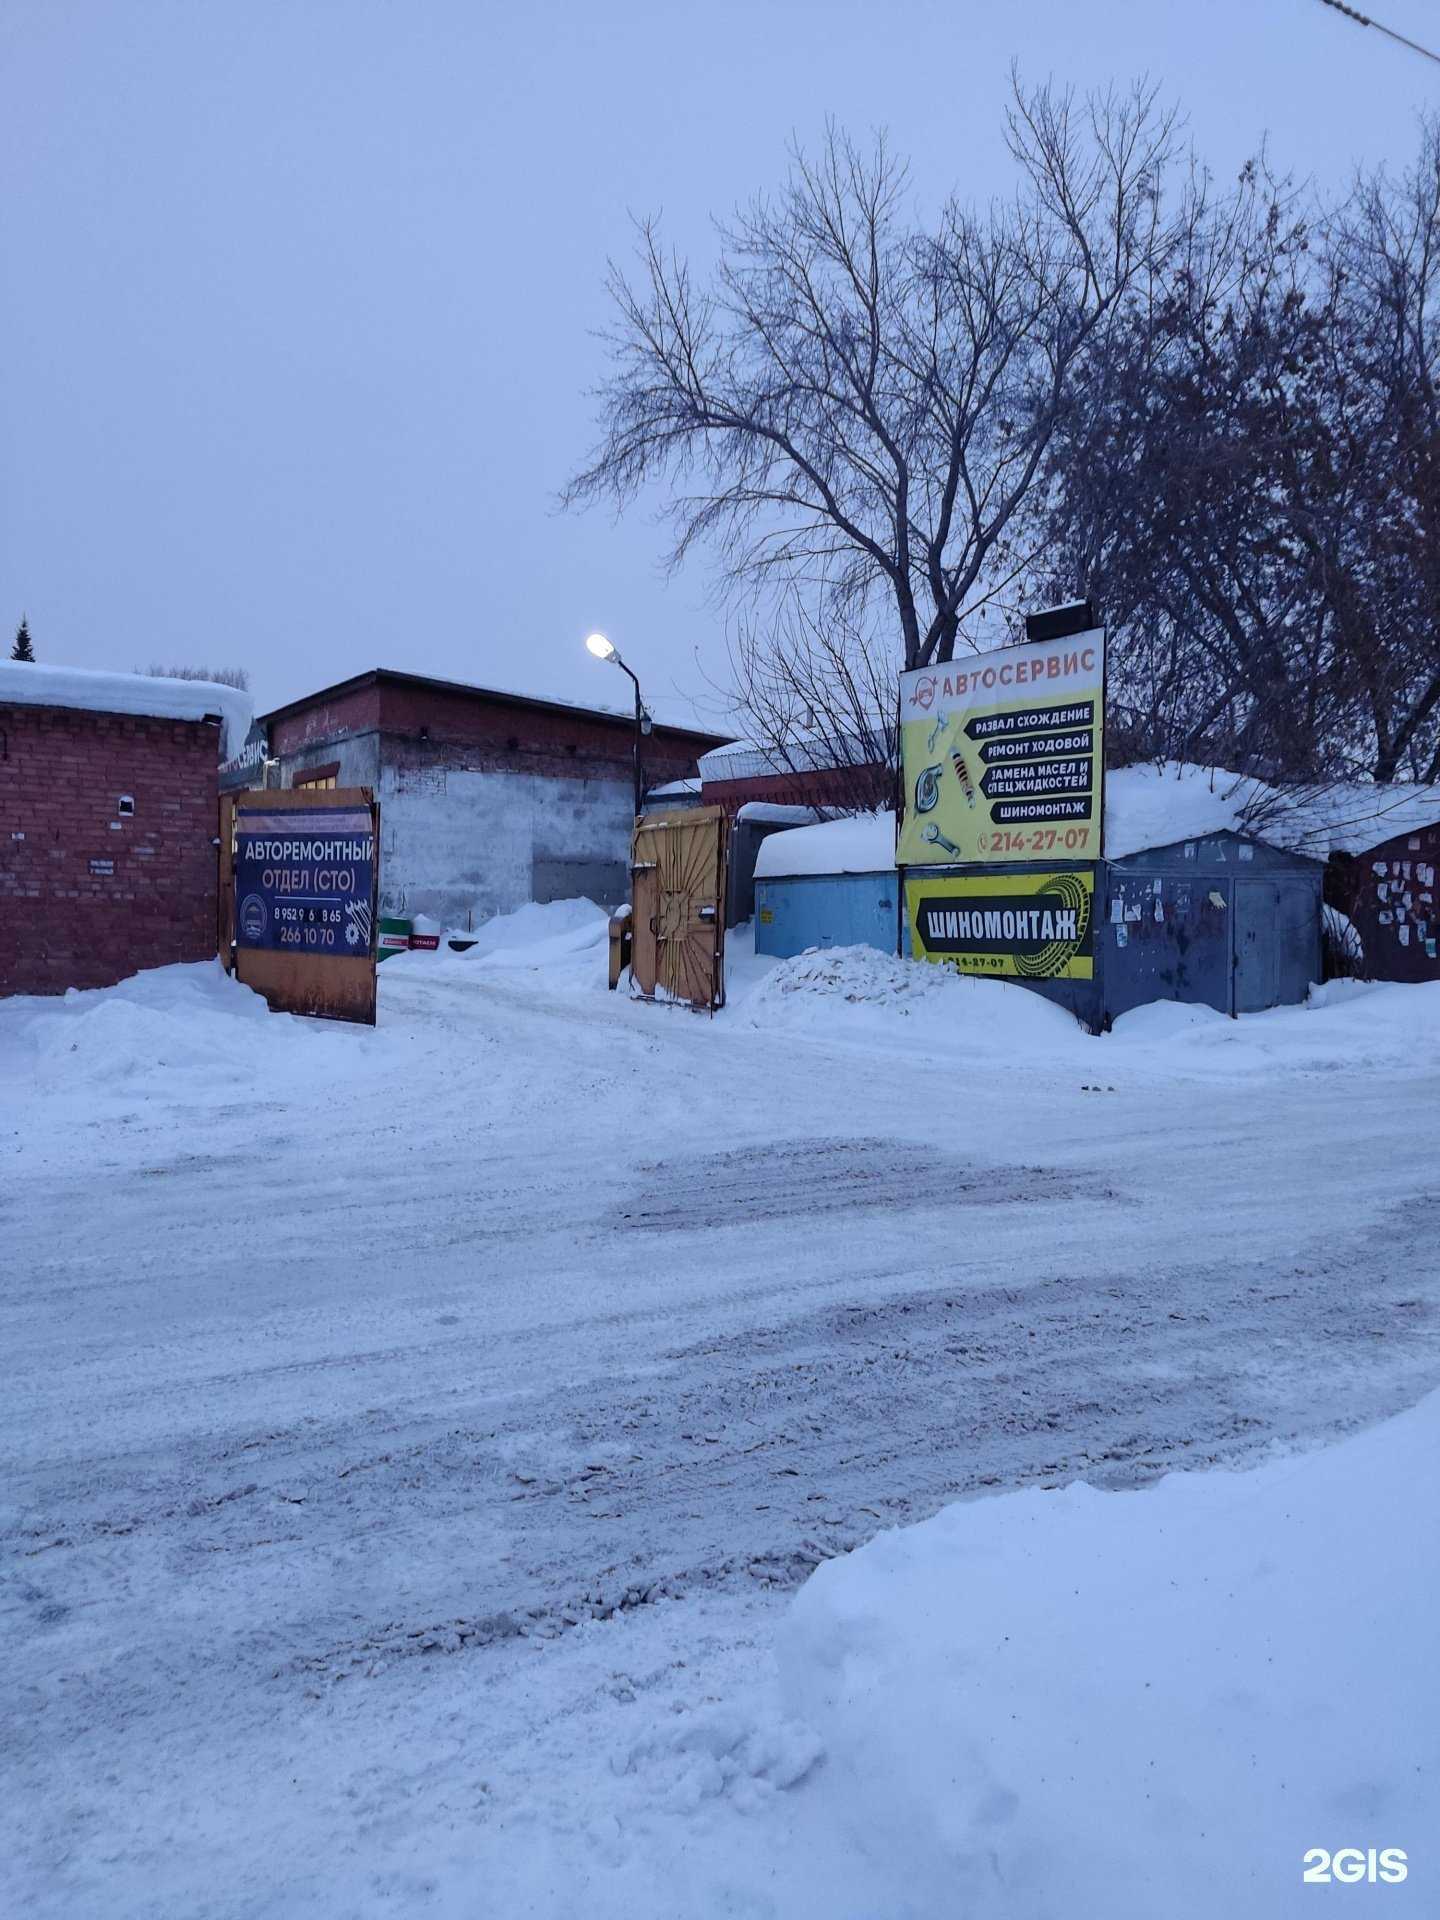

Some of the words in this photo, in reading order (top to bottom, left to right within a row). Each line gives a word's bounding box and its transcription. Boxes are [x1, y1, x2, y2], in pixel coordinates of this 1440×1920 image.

[942, 648, 1096, 699] АВТОСЕРВИС
[975, 718, 1014, 734] РАЗВАЛ
[1017, 707, 1090, 727] СХОЖДЕНИЕ
[988, 742, 1030, 758] РЕМОНТ
[1032, 733, 1089, 752] ХОДОВОЙ
[987, 771, 1088, 794] СПЕЦЖИДКОСТЕЙ
[991, 766, 1035, 780] ЗАМЕНА
[1038, 762, 1076, 776] МАСЕЛ
[1080, 761, 1089, 771] И
[1000, 801, 1085, 818] ШИНОМОНТАЖ
[245, 836, 374, 861] АВТОРЕМОНТНЫЙ
[990, 828, 1090, 853] 214-27-07
[262, 869, 309, 892] ОТДЕЛ
[314, 867, 355, 893] (СТО)
[281, 926, 301, 942] 266
[304, 927, 317, 944] 10
[320, 928, 334, 945] 70
[927, 909, 1076, 940] ШИНОМОНТАЖ
